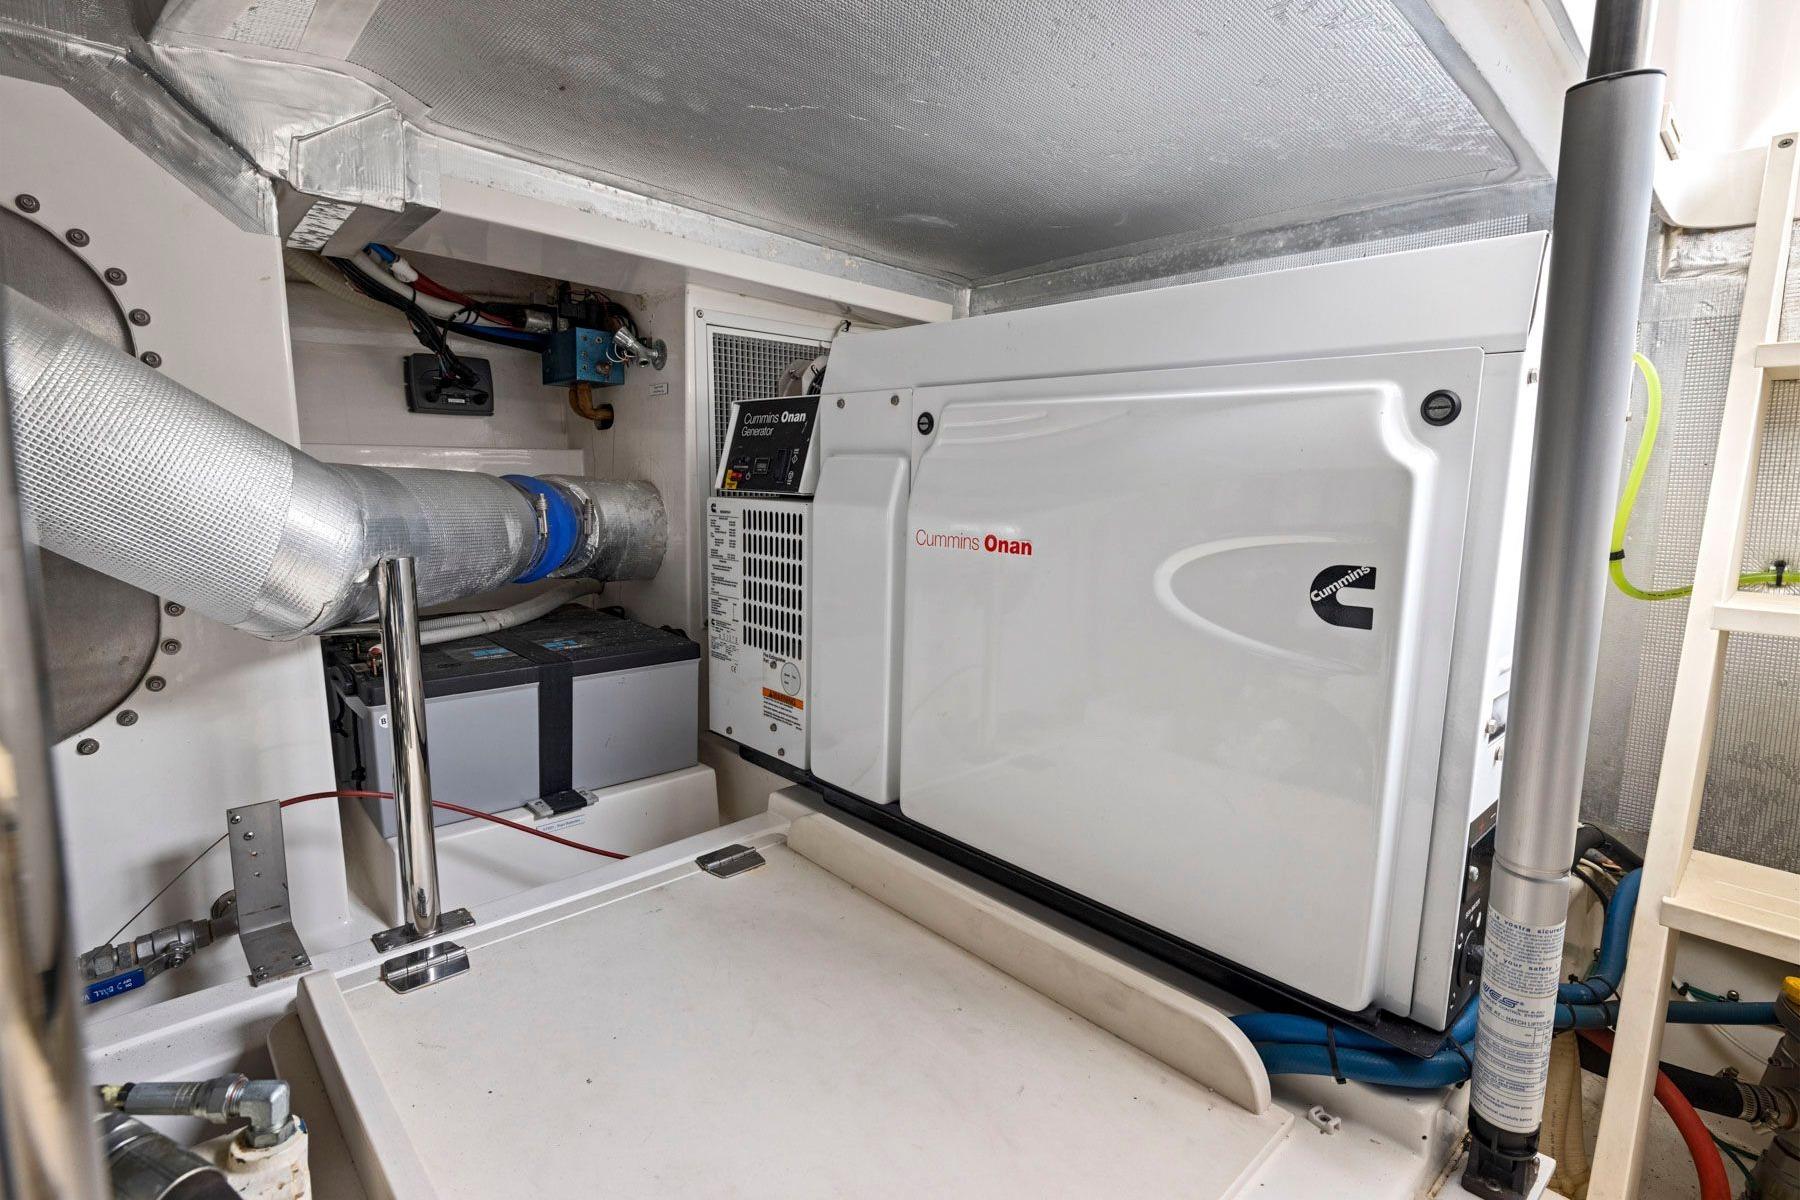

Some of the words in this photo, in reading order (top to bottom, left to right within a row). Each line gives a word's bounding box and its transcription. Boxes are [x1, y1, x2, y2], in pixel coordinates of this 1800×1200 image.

[744, 412, 779, 425] Cummins
[781, 411, 807, 423] Onan
[741, 426, 775, 437] Generator
[915, 529, 980, 551] Cummins
[984, 534, 1032, 556] Onan
[1310, 566, 1371, 602] Cummins
